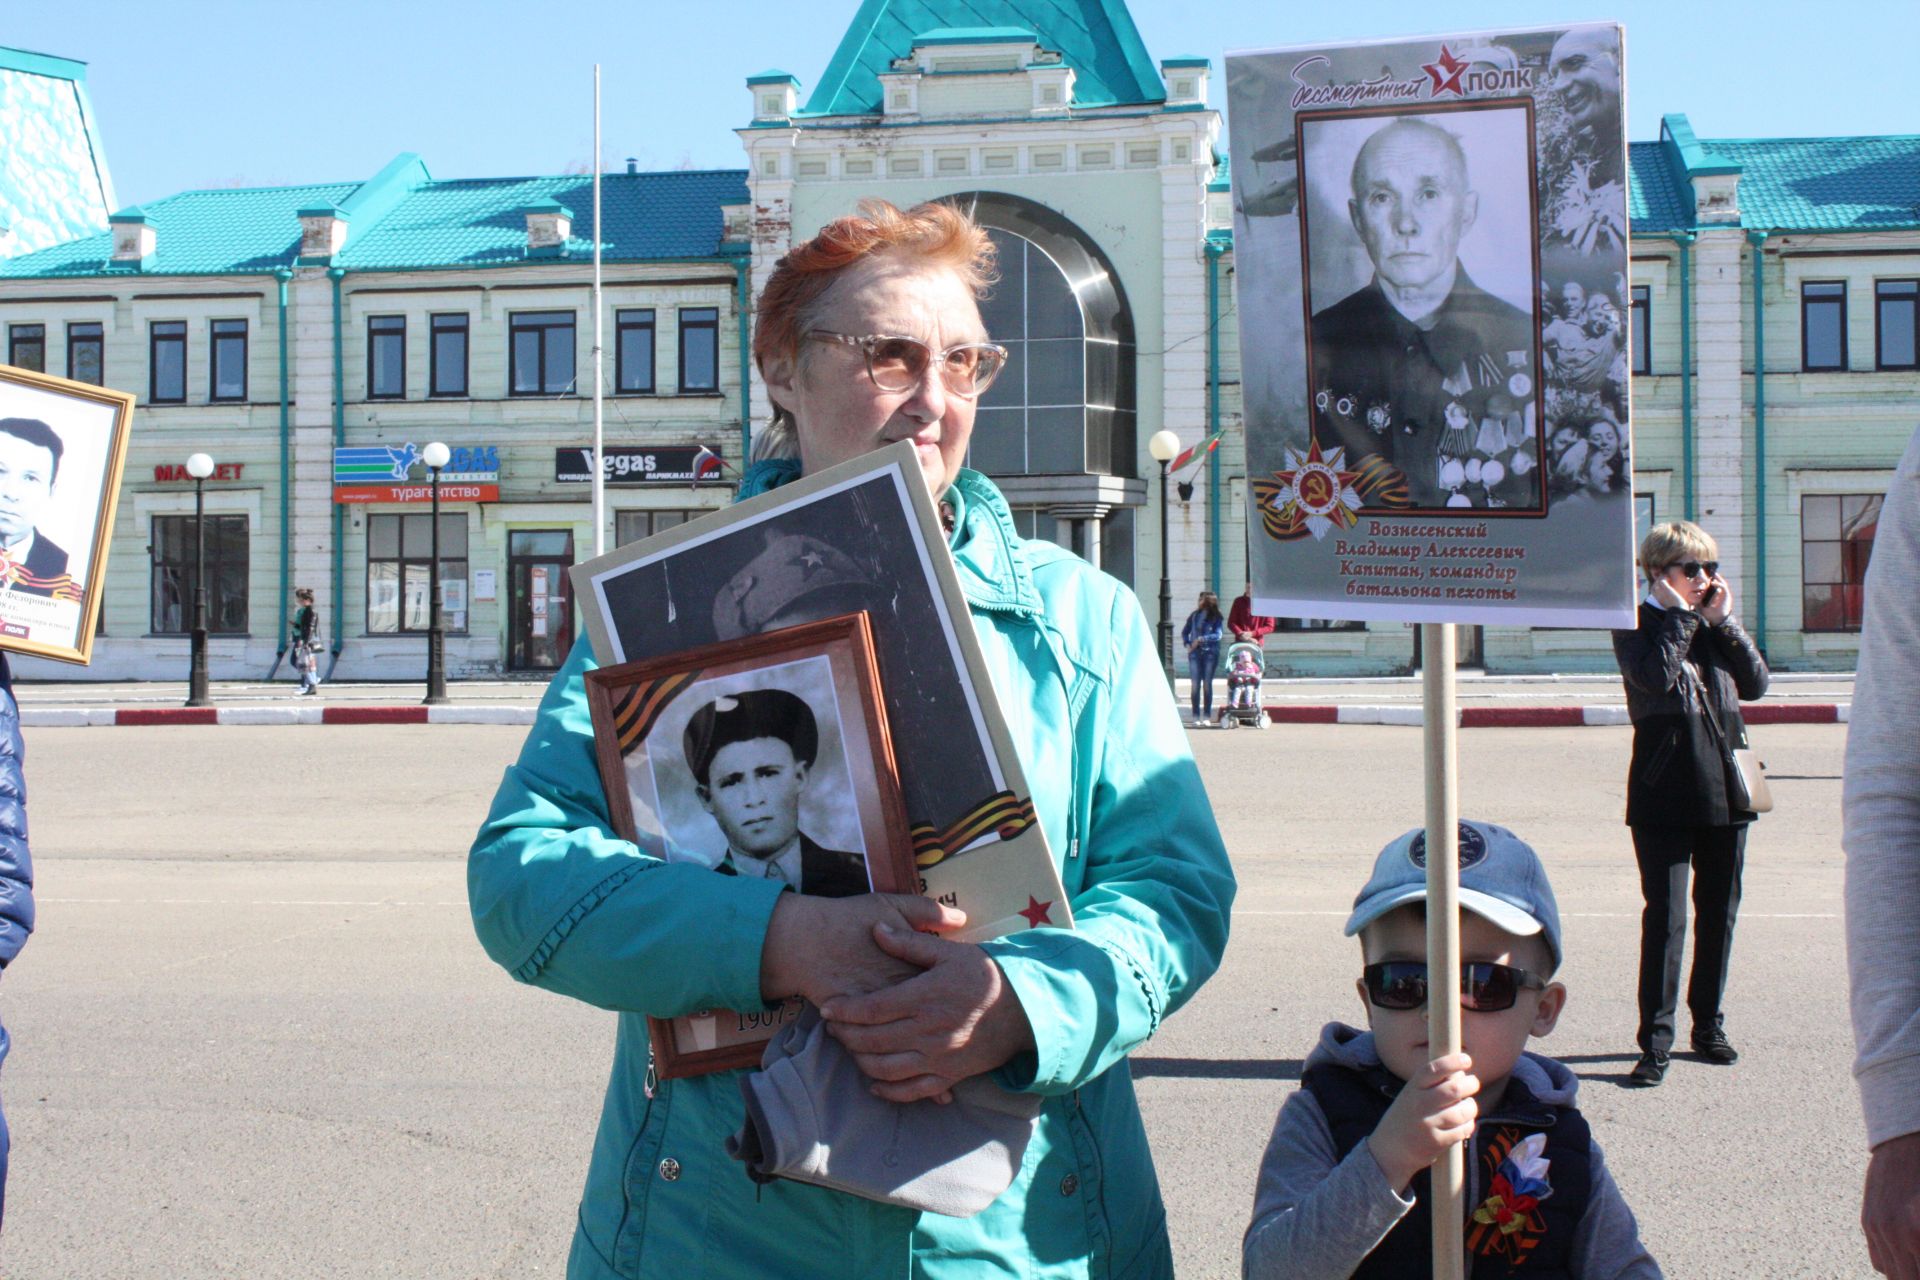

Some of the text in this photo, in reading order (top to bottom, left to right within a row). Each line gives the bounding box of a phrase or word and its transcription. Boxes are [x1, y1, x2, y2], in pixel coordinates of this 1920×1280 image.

[581, 449, 657, 475] Vegas
[154, 464, 245, 482] МАЕТ
[1368, 521, 1488, 538] Вознесенский
[1335, 540, 1525, 561] Владимир Алексеевич
[1340, 560, 1517, 584] Капитан, командир
[1346, 580, 1517, 600] батальона пехоты
